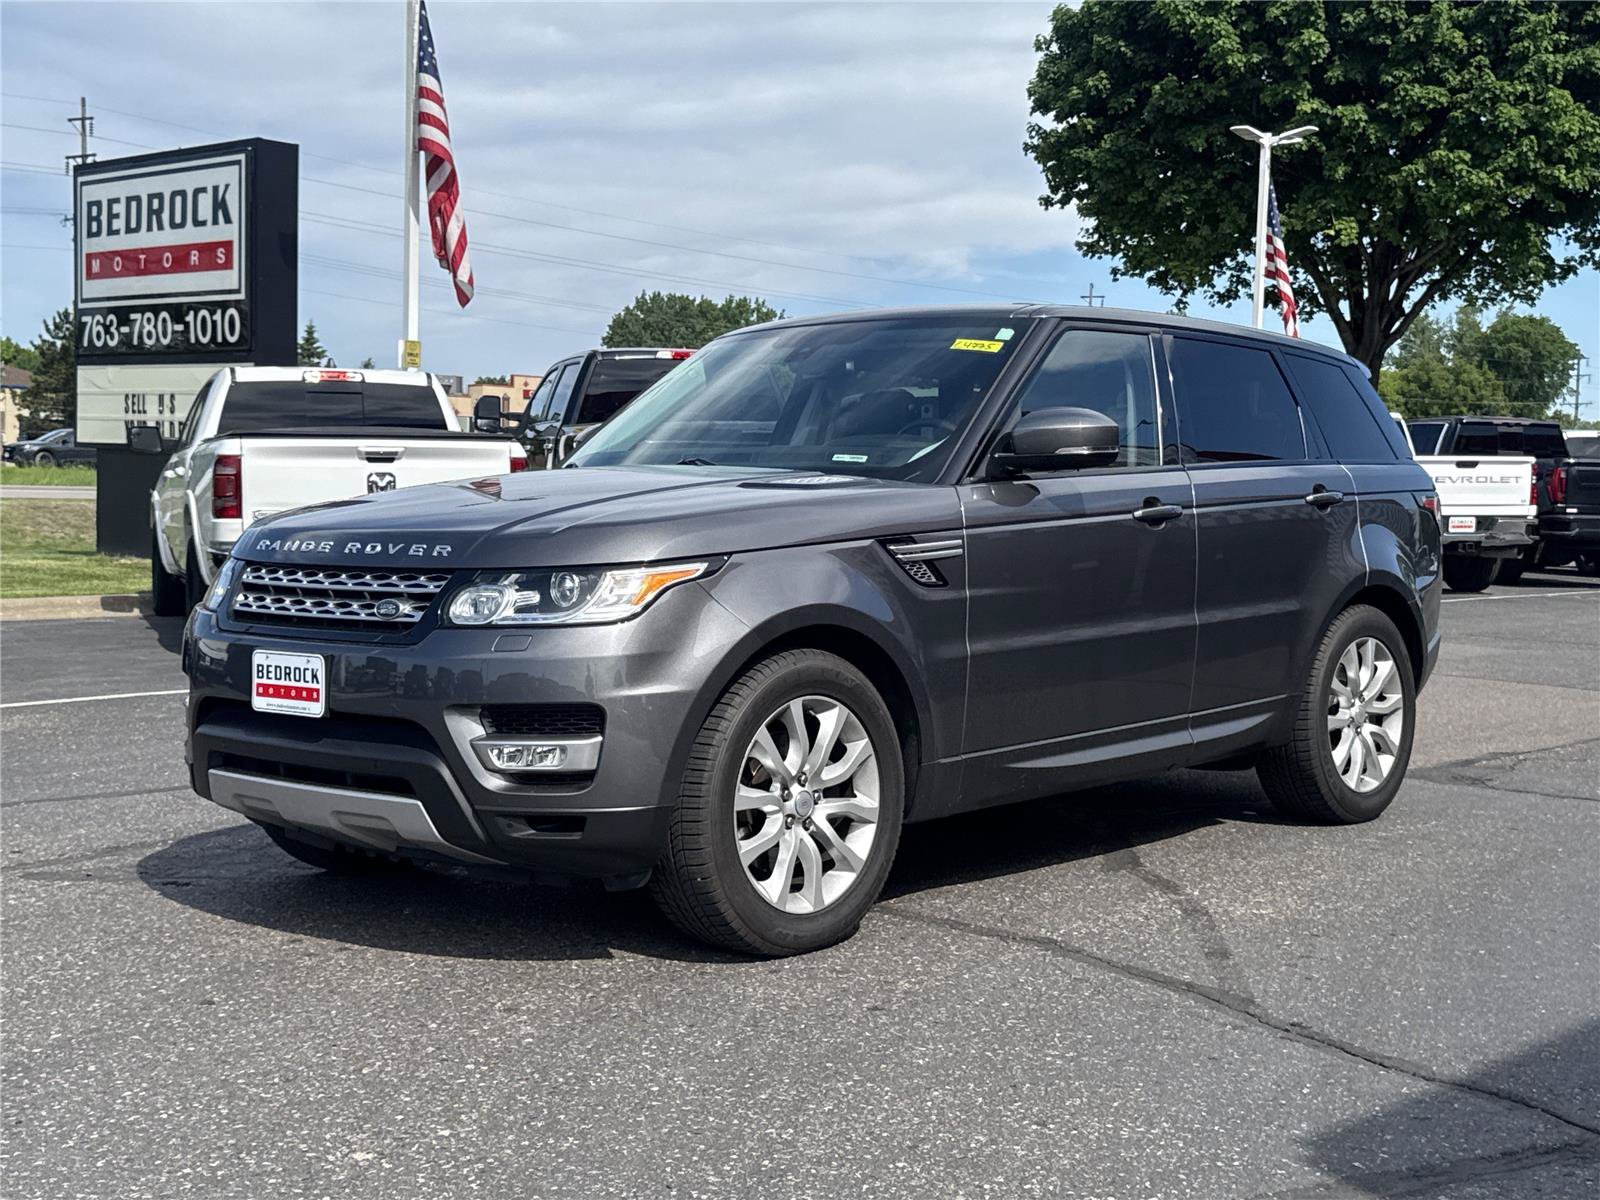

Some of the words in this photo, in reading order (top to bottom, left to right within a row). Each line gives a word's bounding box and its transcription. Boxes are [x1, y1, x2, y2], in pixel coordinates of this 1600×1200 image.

[86, 183, 233, 239] BEDROCK
[92, 247, 226, 274] MOTORS
[81, 307, 241, 347] 763-780-1010
[124, 393, 147, 414] SELL
[1434, 475, 1523, 484] EVROLET
[256, 539, 334, 552] RANGE
[344, 542, 452, 557] ROVER
[256, 663, 320, 684] BEDROCK
